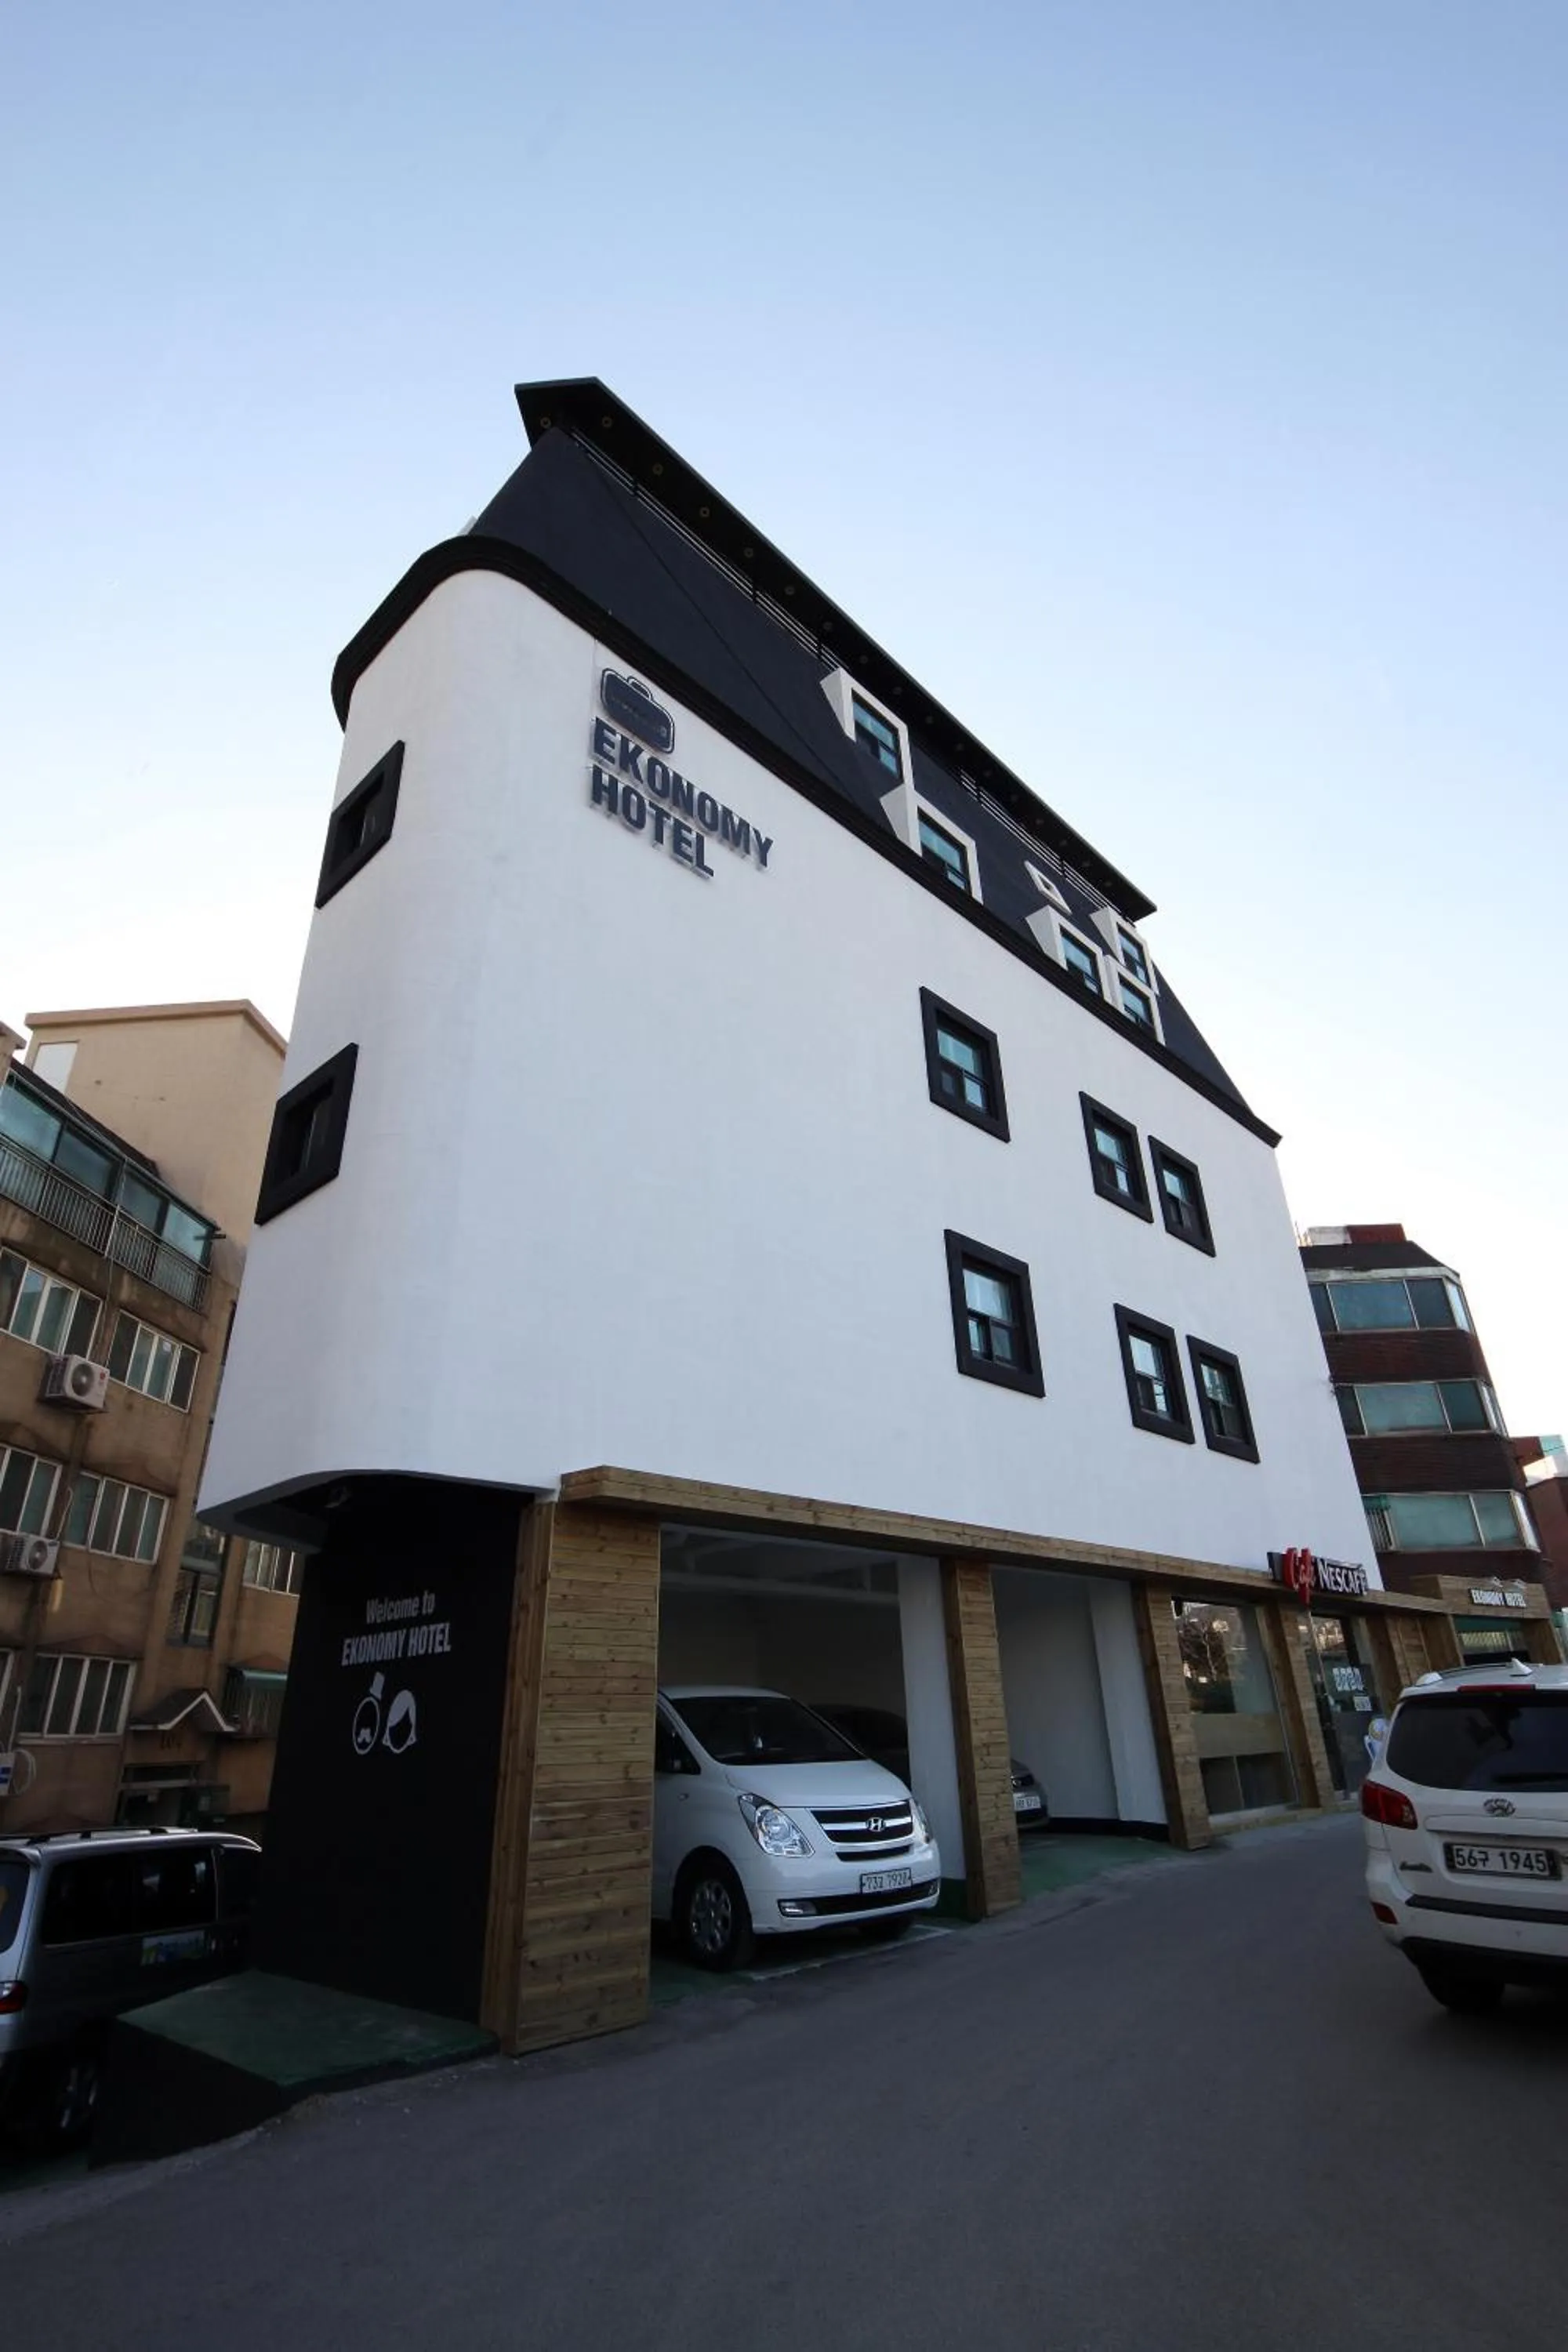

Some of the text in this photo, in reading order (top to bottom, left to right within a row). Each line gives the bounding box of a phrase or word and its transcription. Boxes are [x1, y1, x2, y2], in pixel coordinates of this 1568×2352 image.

[592, 716, 774, 868] EKONOMY
[591, 764, 714, 878] HOTEL
[366, 1589, 435, 1624] Welcome to
[341, 1621, 452, 1667] EKONOMY HOTEL
[1498, 1851, 1546, 1872] 1945
